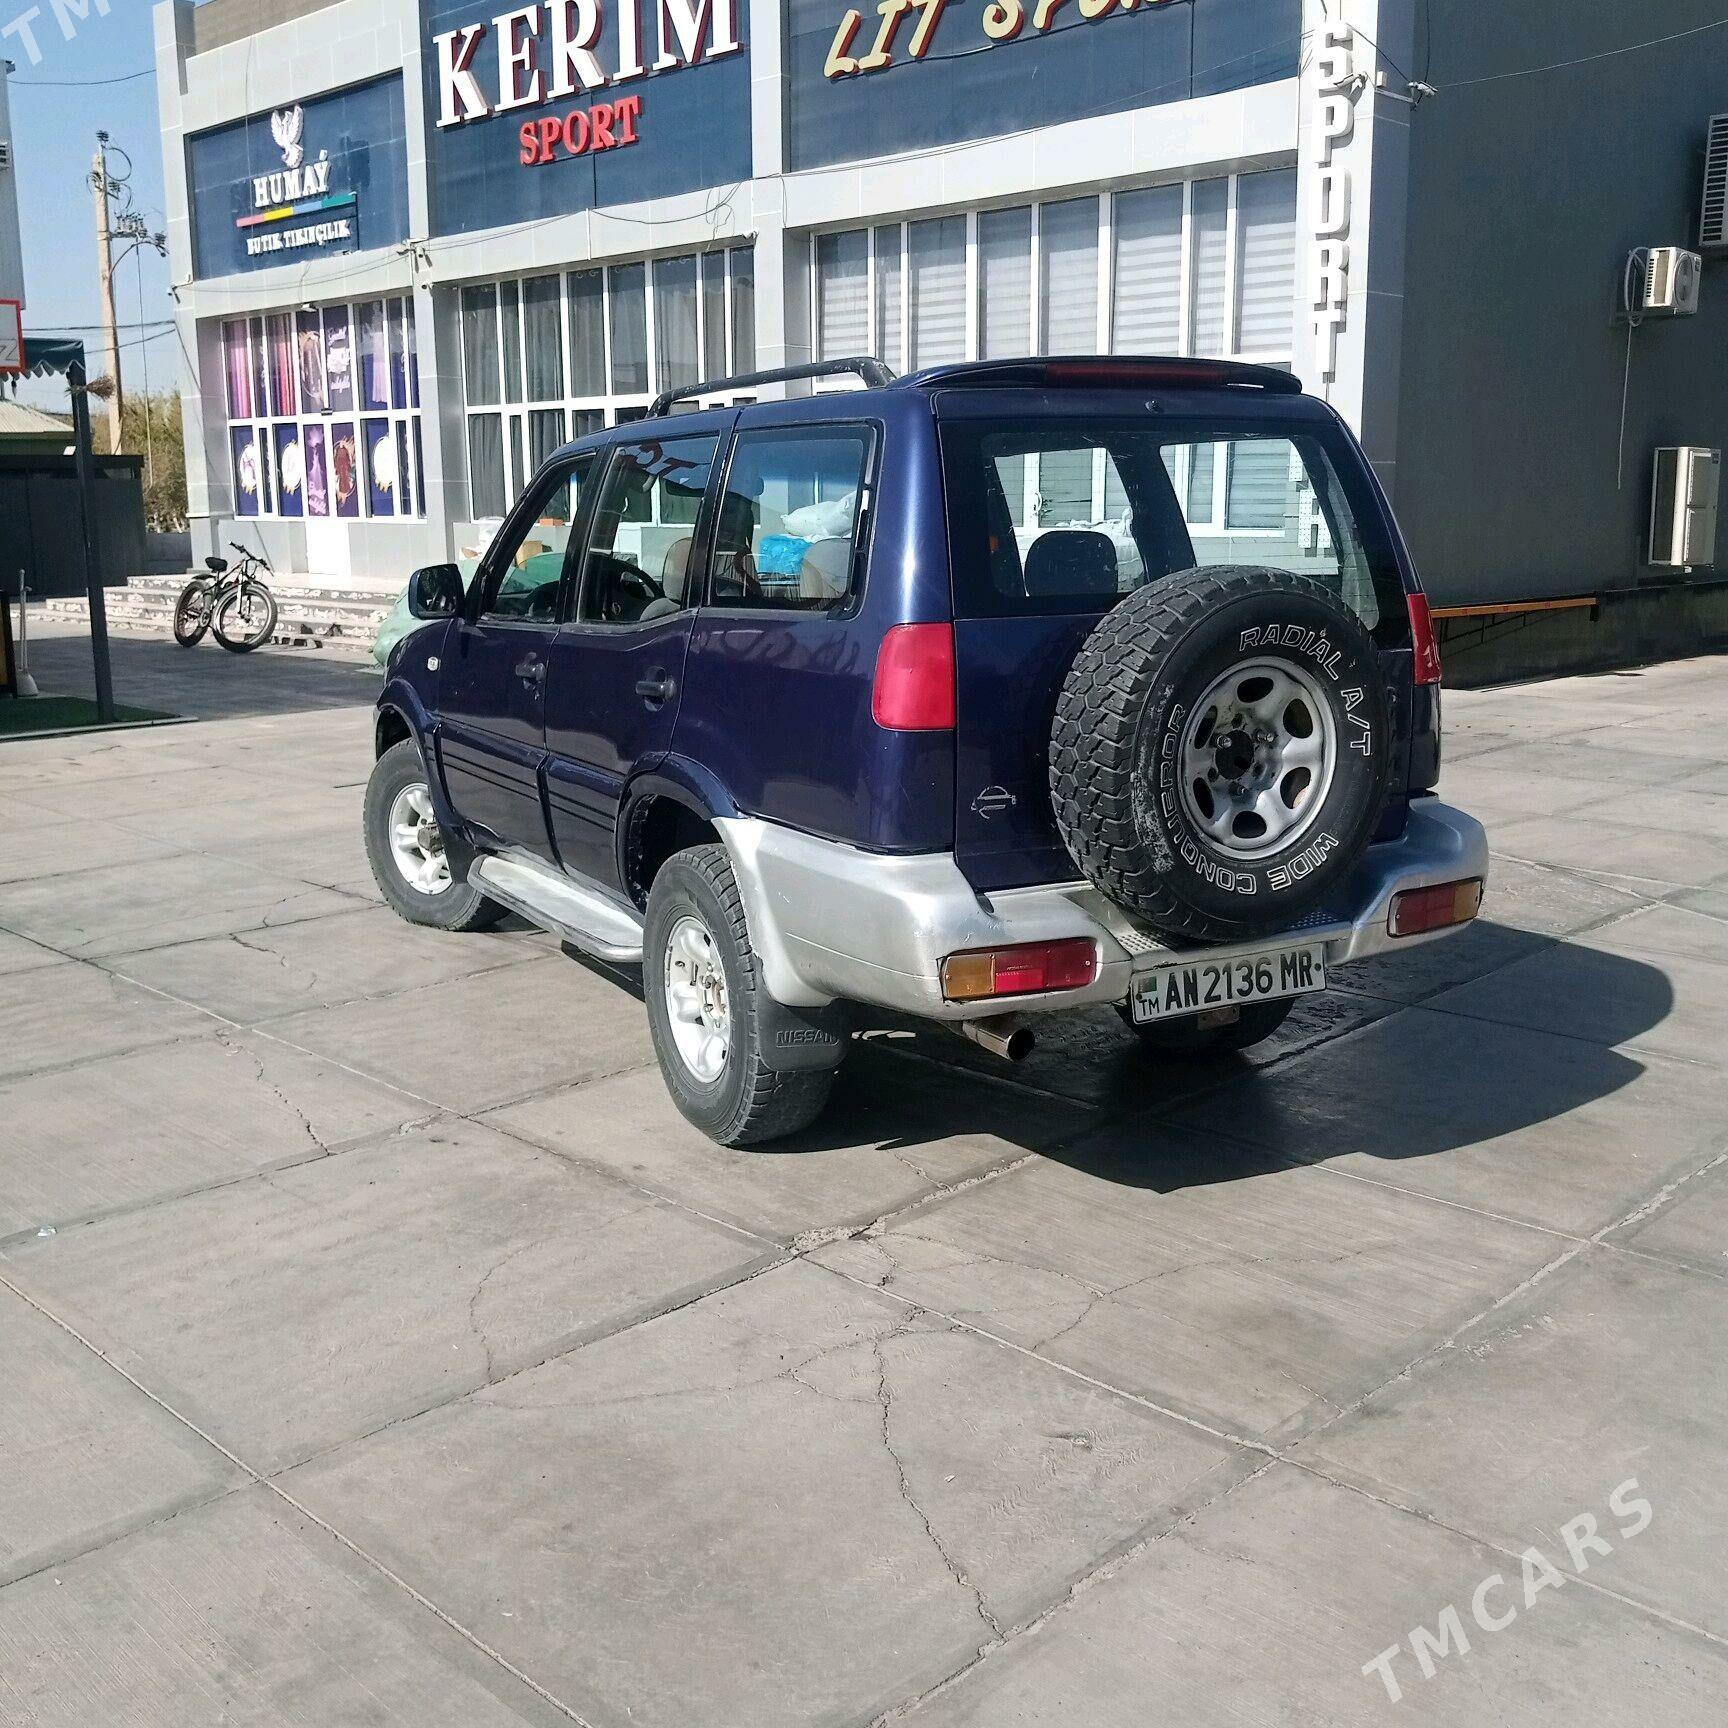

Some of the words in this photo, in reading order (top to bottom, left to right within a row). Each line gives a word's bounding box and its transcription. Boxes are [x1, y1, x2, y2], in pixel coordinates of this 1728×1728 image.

[433, 0, 742, 127] KERIM
[520, 95, 641, 165] SPORT
[1308, 22, 1352, 374] SPORT
[1239, 624, 1341, 680] RADIAL
[1341, 687, 1371, 756] A/T
[1160, 703, 1258, 895] CONQUEROR
[1267, 832, 1339, 891] WIDE
[1139, 996, 1160, 1017] TM
[1165, 968, 1199, 1012] AN
[1203, 956, 1274, 1004] 2136
[1280, 950, 1314, 991] MR
[776, 1029, 837, 1045] NISSAN
